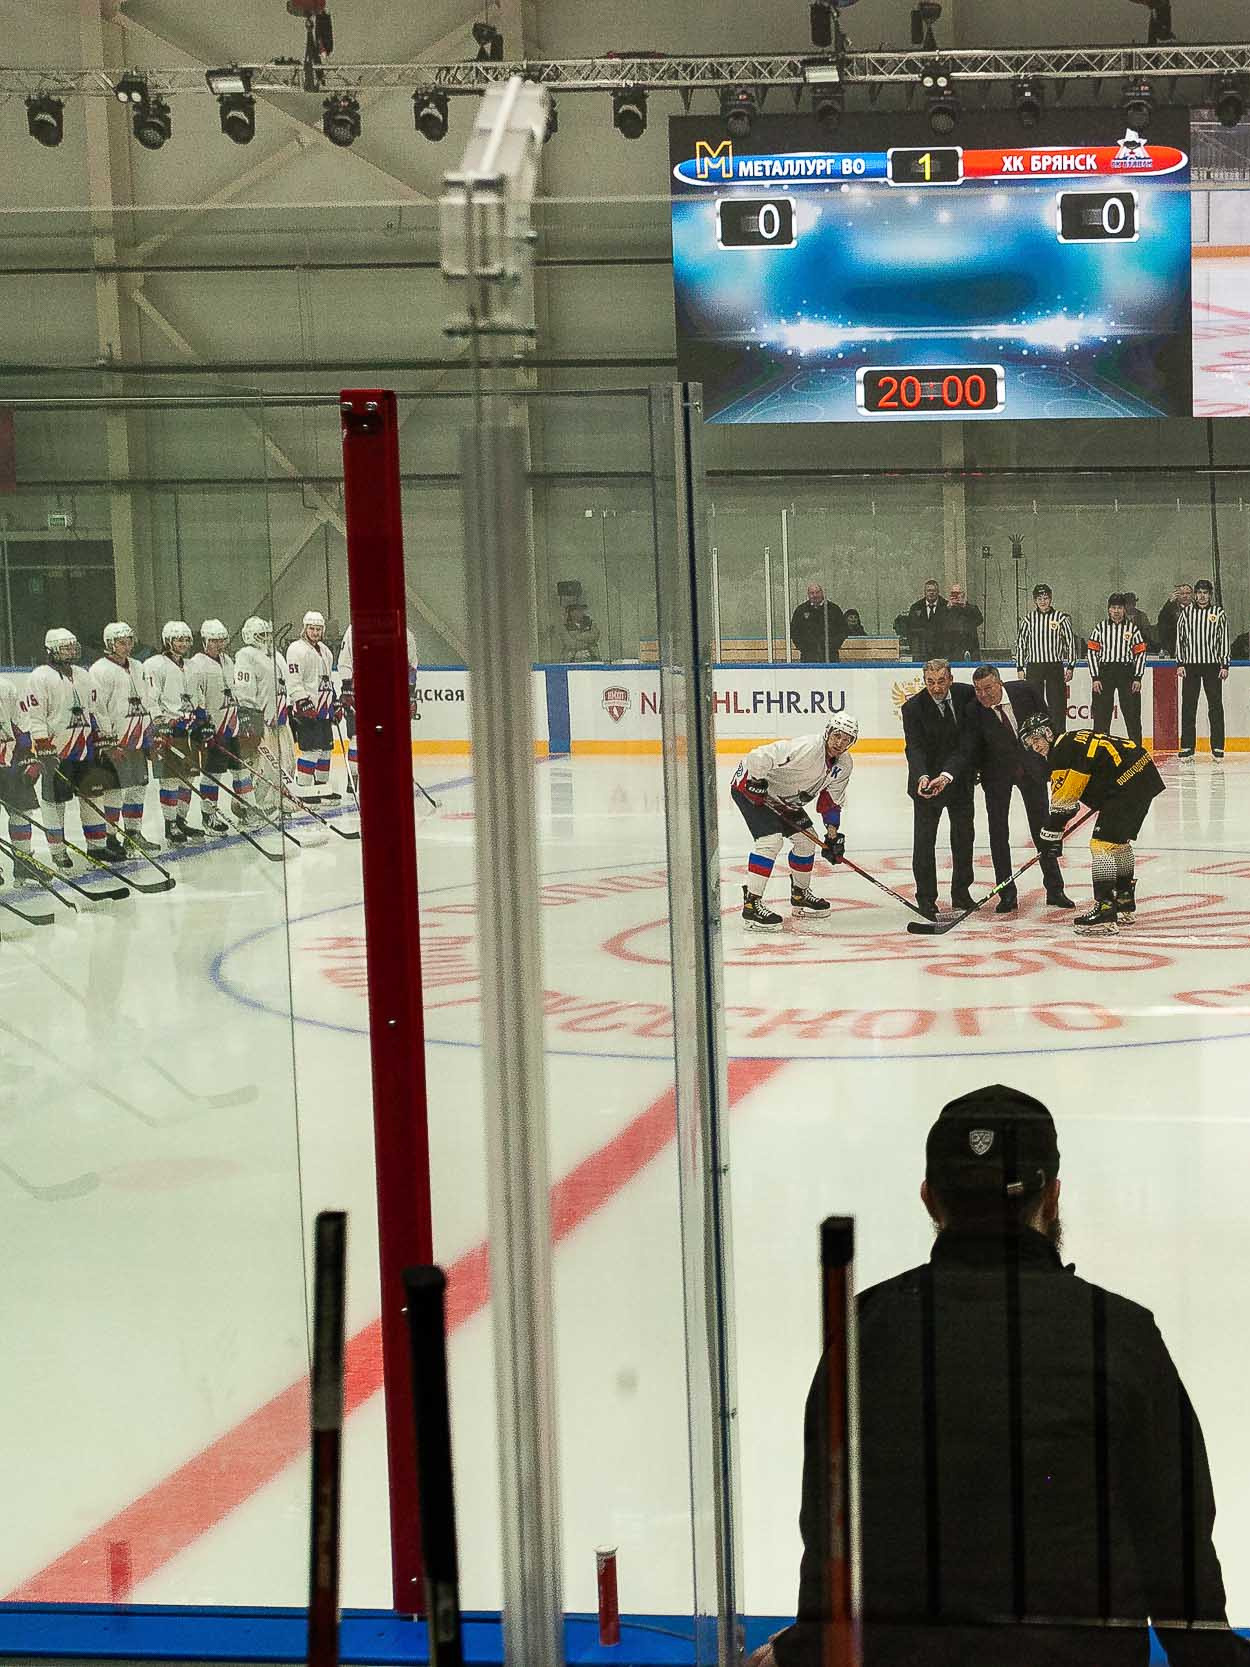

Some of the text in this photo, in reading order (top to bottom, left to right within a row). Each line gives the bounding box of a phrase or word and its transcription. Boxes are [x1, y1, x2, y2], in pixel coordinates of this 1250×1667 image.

[738, 158, 866, 178] МЕТАЛЛУРГ ВО
[916, 151, 933, 183] 1
[1001, 154, 1025, 173] ХК
[1030, 152, 1098, 173] БРЯНСК
[757, 203, 781, 239] 0
[1102, 197, 1126, 234] 0
